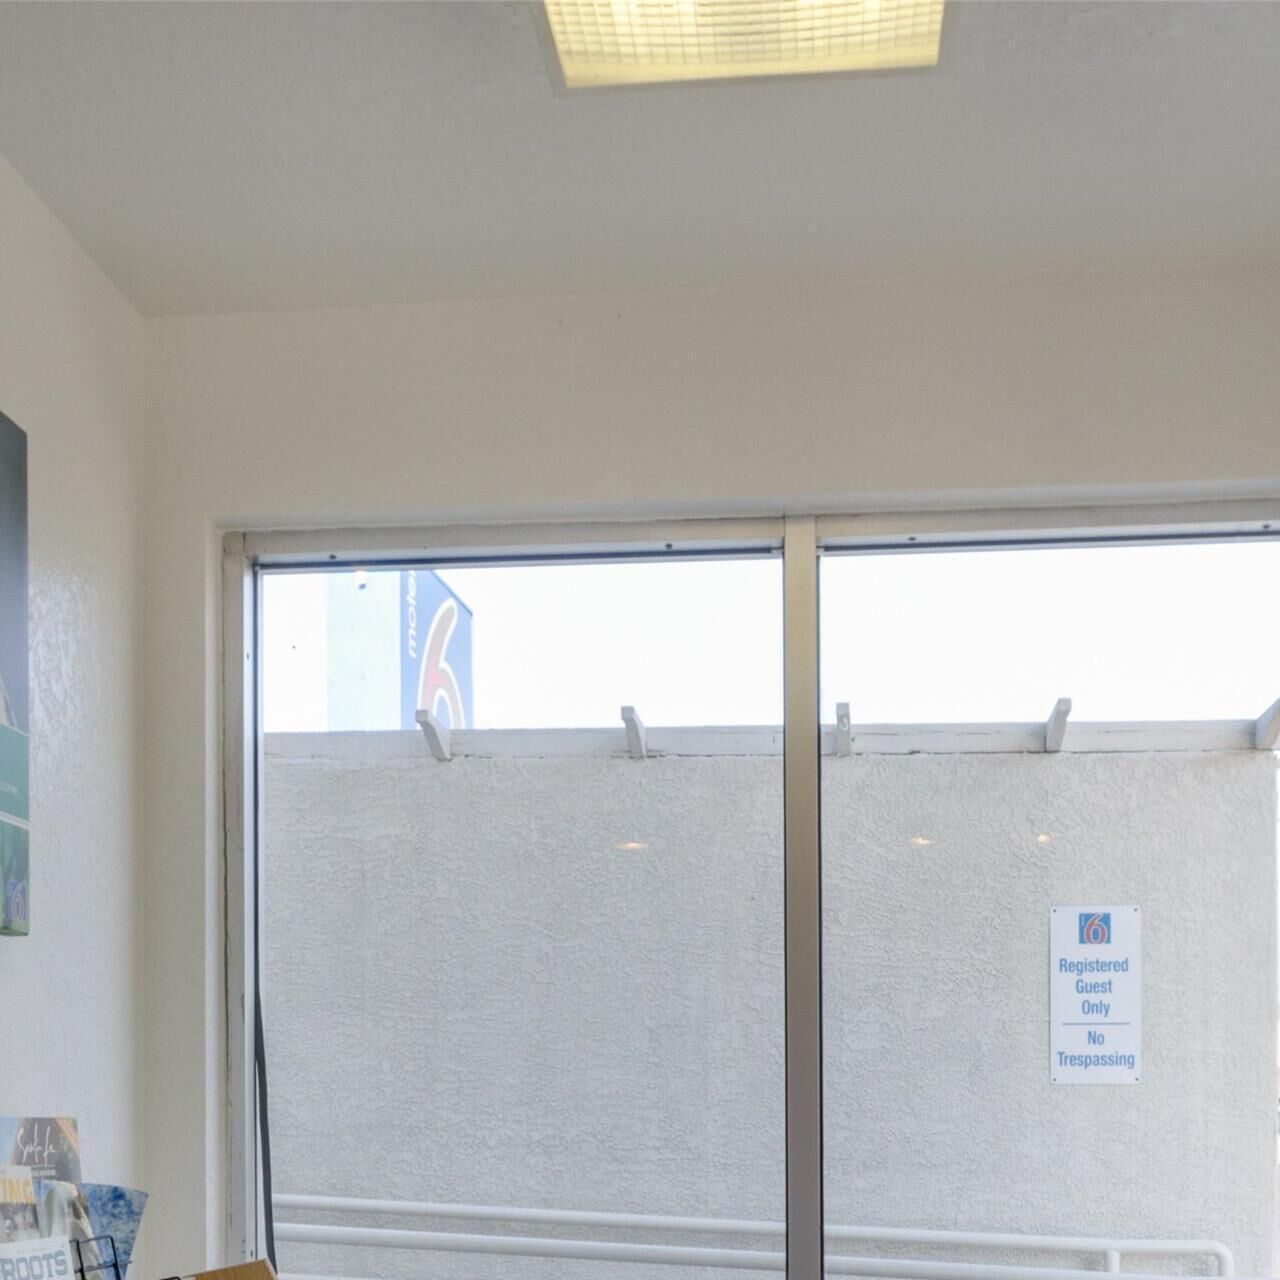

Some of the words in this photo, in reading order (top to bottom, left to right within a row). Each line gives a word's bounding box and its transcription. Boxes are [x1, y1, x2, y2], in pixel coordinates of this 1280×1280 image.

[416, 597, 465, 730] 6
[1083, 913, 1108, 944] 6
[1059, 958, 1129, 976] Registered
[1075, 979, 1112, 994] Guest
[1082, 1000, 1110, 1017] Only
[1087, 1031, 1105, 1045] No
[1057, 1052, 1135, 1069] Trespassing
